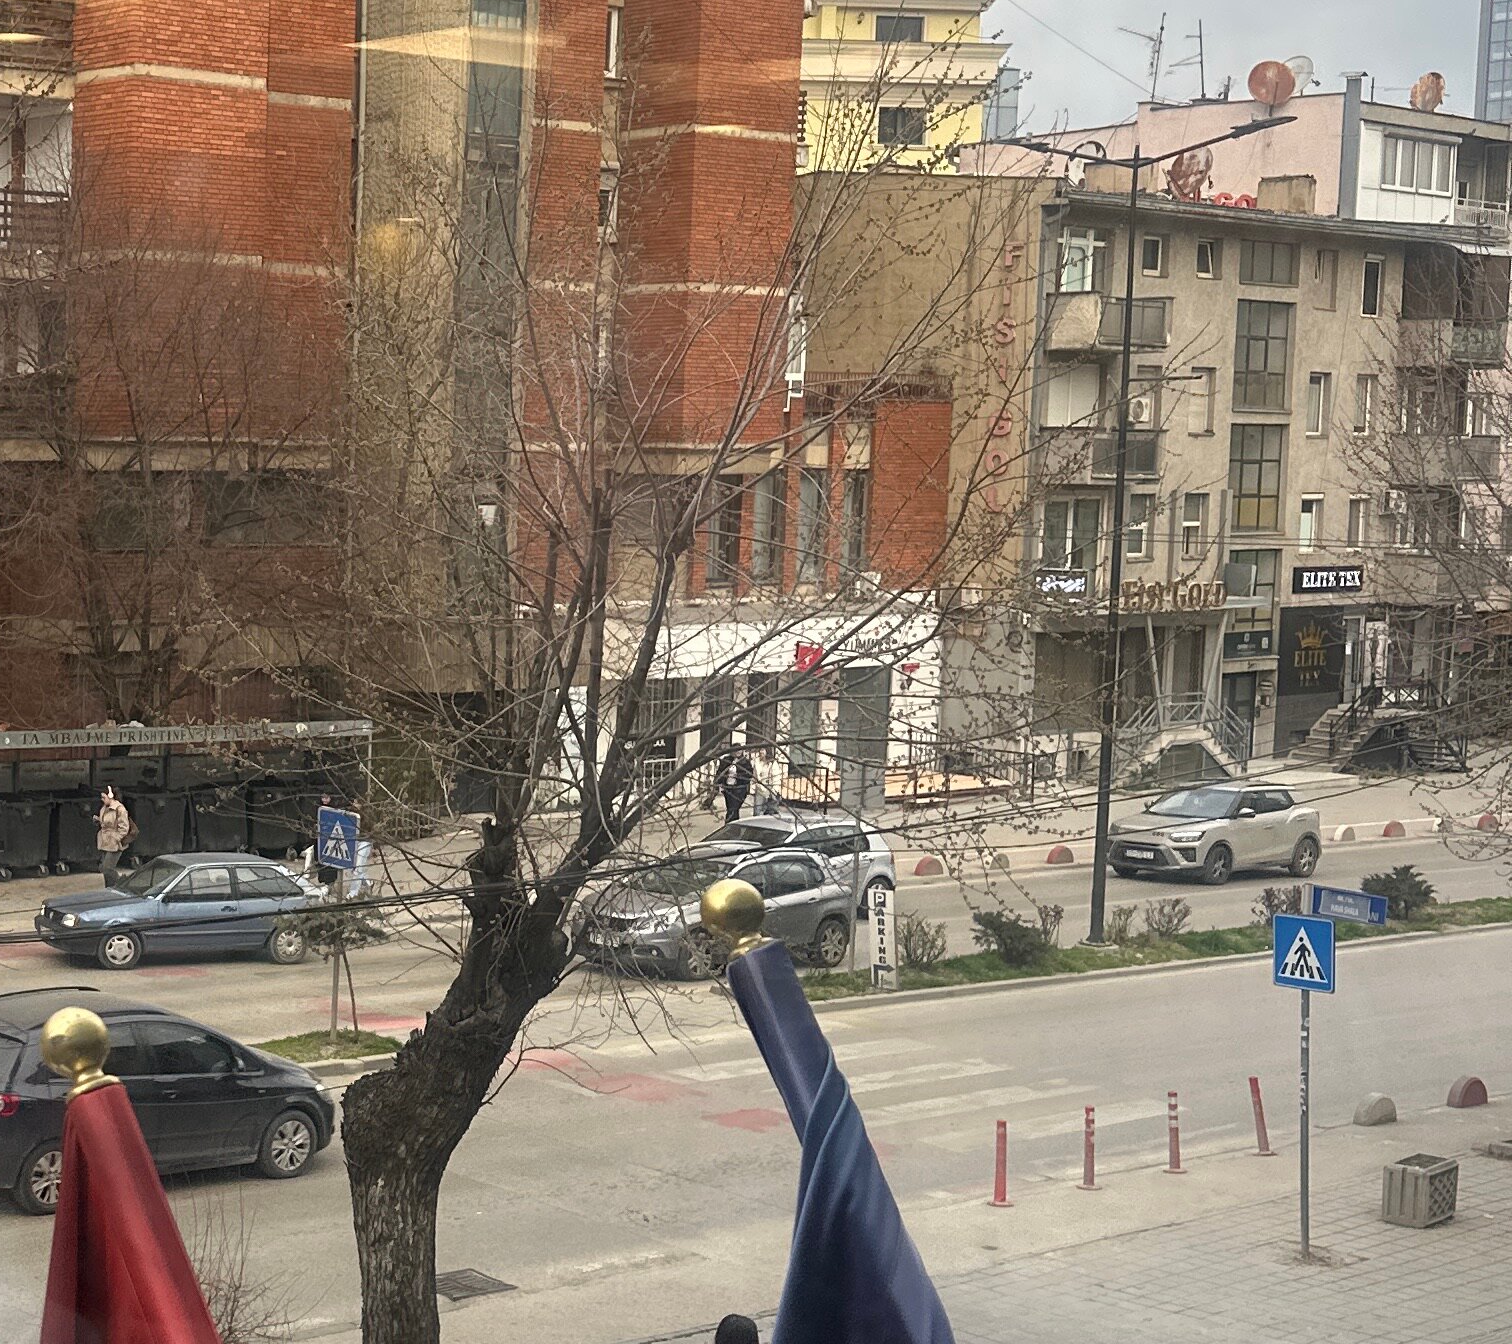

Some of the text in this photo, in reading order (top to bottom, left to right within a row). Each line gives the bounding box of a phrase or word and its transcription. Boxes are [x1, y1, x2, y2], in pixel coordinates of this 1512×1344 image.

[1302, 570, 1361, 588] ELITE TEX
[1294, 650, 1327, 667] ELITE
[874, 892, 887, 964] PARKING
